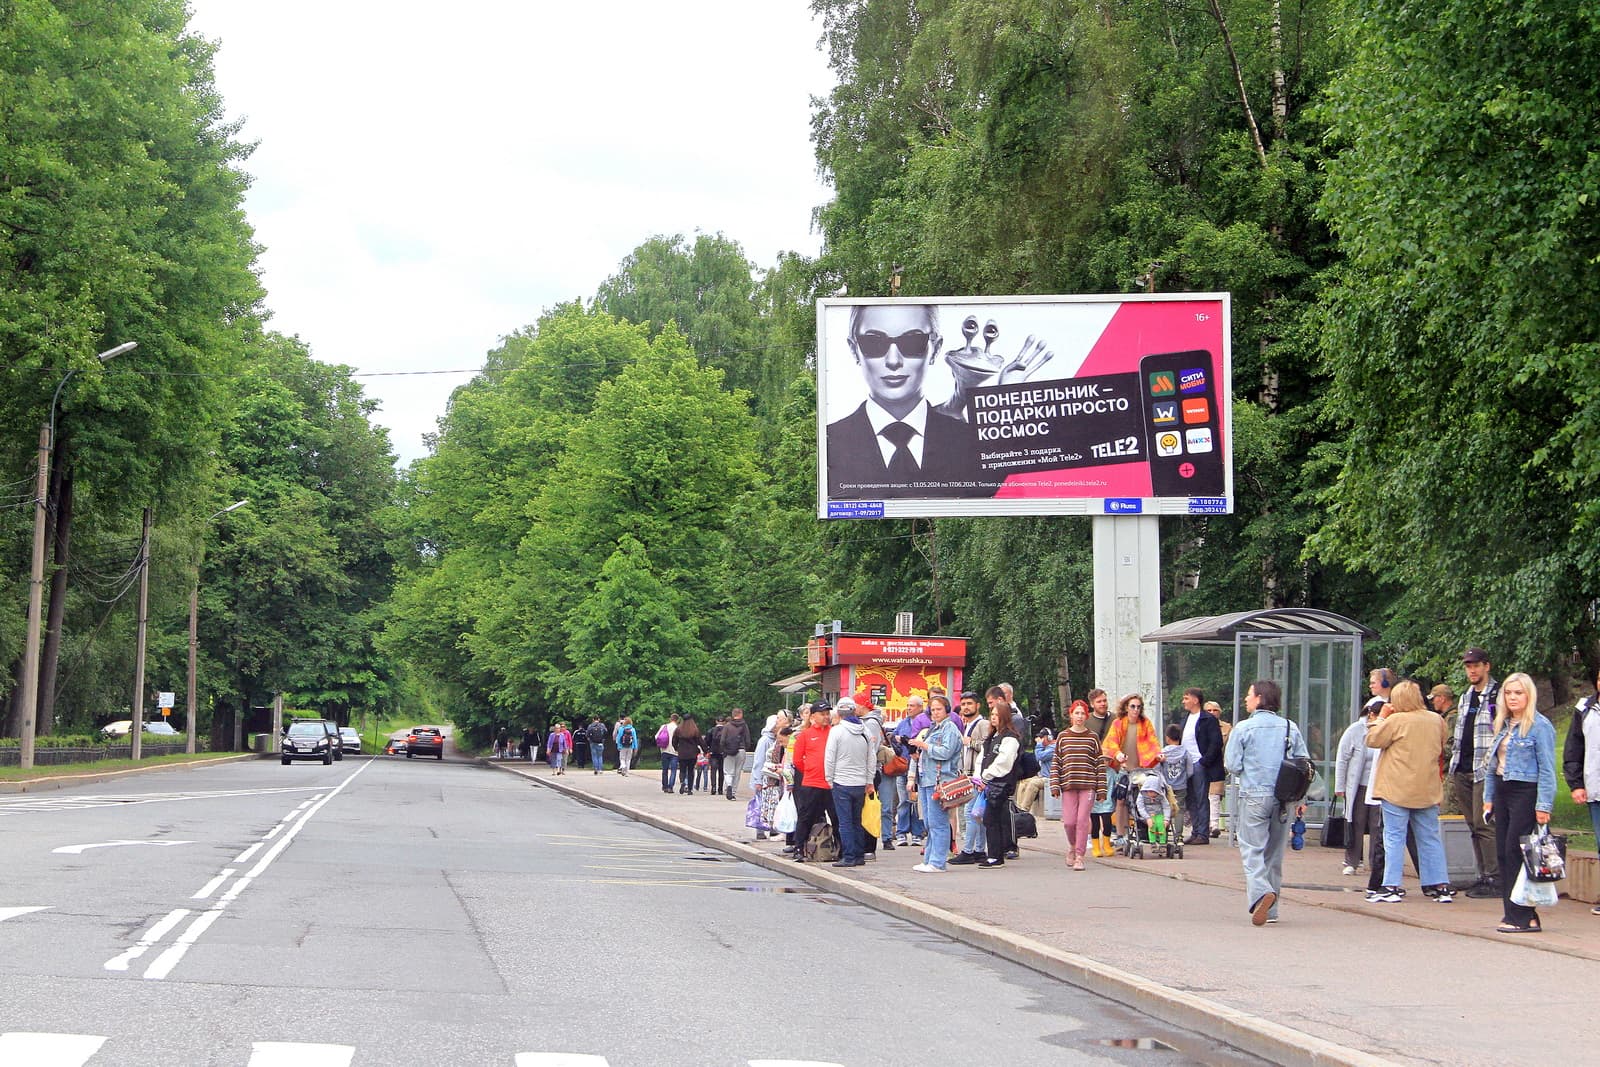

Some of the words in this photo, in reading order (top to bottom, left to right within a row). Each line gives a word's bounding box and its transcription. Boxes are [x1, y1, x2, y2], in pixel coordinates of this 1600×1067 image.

[1194, 313, 1211, 321] 16+
[1181, 371, 1204, 383] СИТИ
[974, 383, 1100, 409] ПОНЕДЕЛЬНИК
[976, 404, 1057, 425] ПОДАРКИ
[1060, 397, 1129, 417] ПРОСТО
[977, 421, 1050, 441] КОСМОС
[980, 450, 1023, 461] Выбирайте
[1023, 448, 1029, 456] 3
[1030, 446, 1062, 456] подарка
[1090, 436, 1139, 459] TELE2
[988, 458, 1036, 470] приложении
[1037, 455, 1058, 464] «Мой
[1059, 452, 1083, 462] Tele2»
[839, 482, 857, 490] Сроки
[872, 656, 933, 665] www.watrushka.ru
